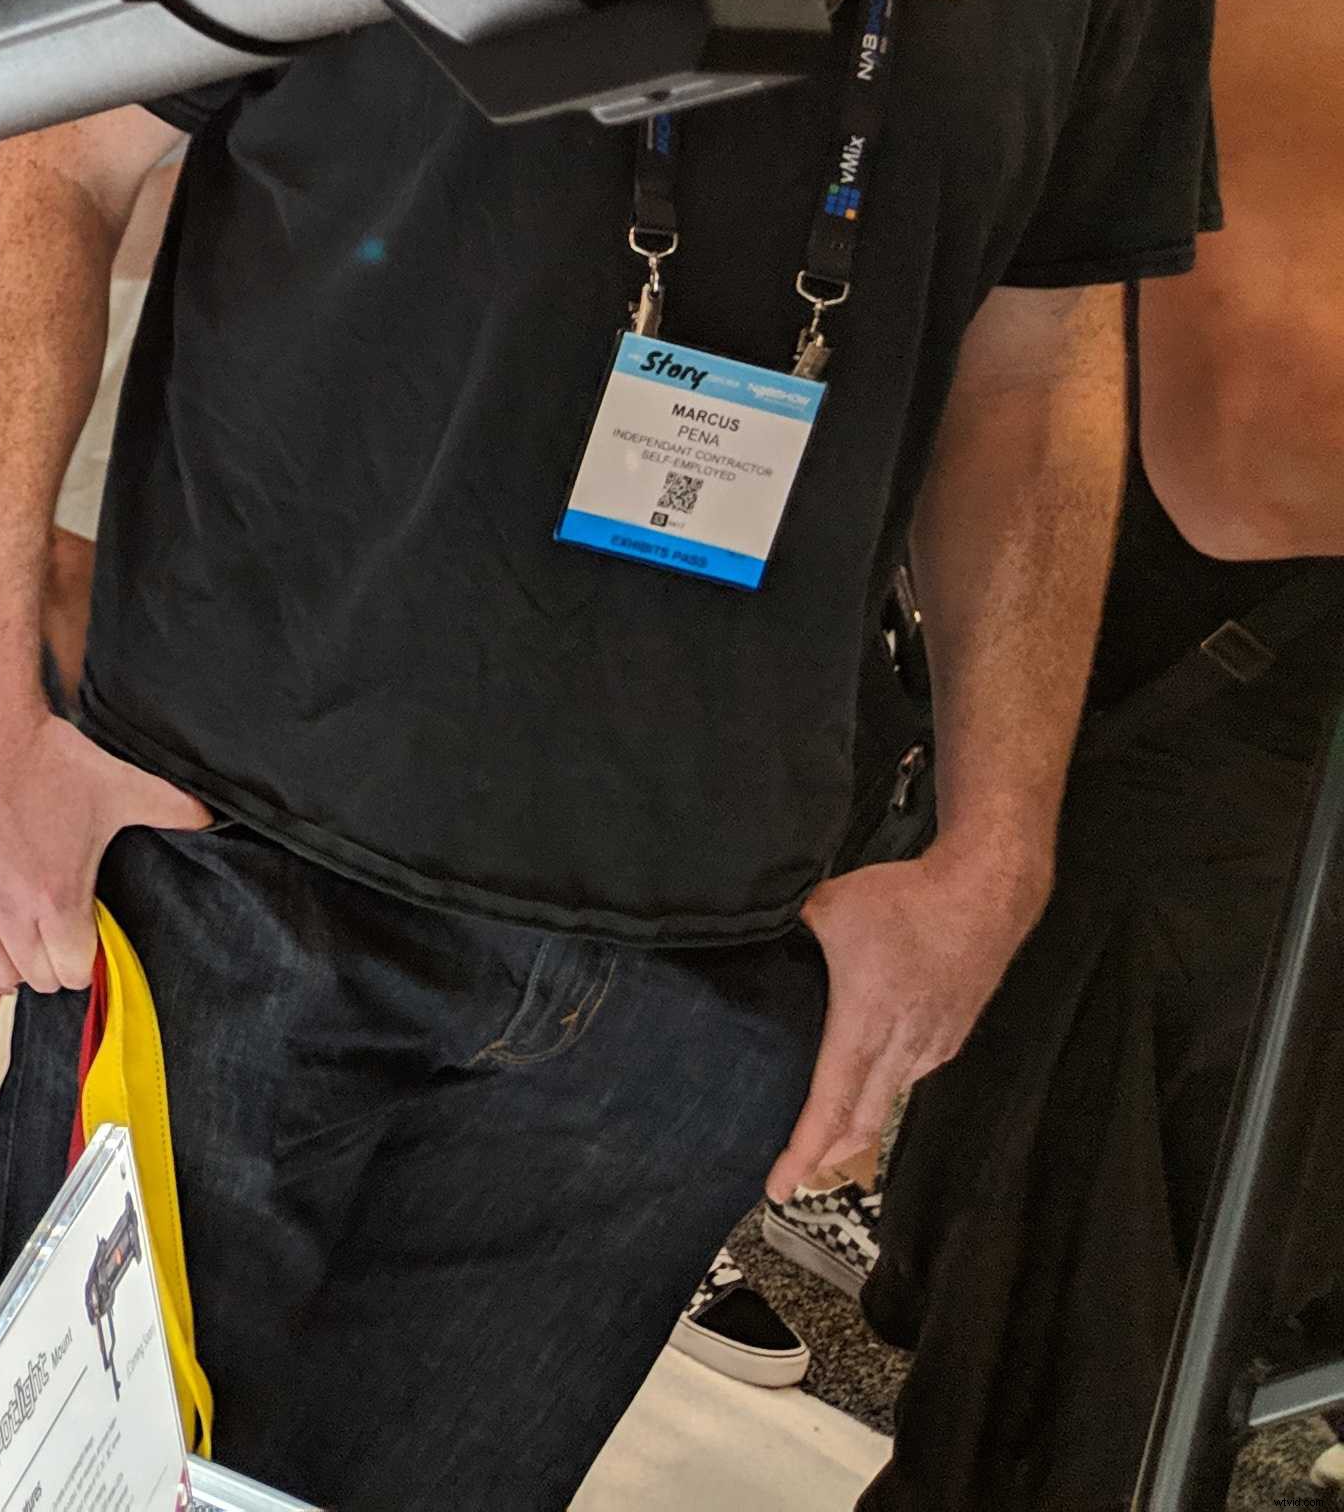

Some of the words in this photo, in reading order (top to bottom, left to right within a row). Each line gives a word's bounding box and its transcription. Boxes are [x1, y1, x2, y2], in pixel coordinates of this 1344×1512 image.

[840, 135, 866, 184] vMix
[639, 350, 709, 391] Story
[671, 402, 741, 432] MARCUS
[677, 424, 721, 448] PENA
[694, 449, 775, 478] CONTRACTOR
